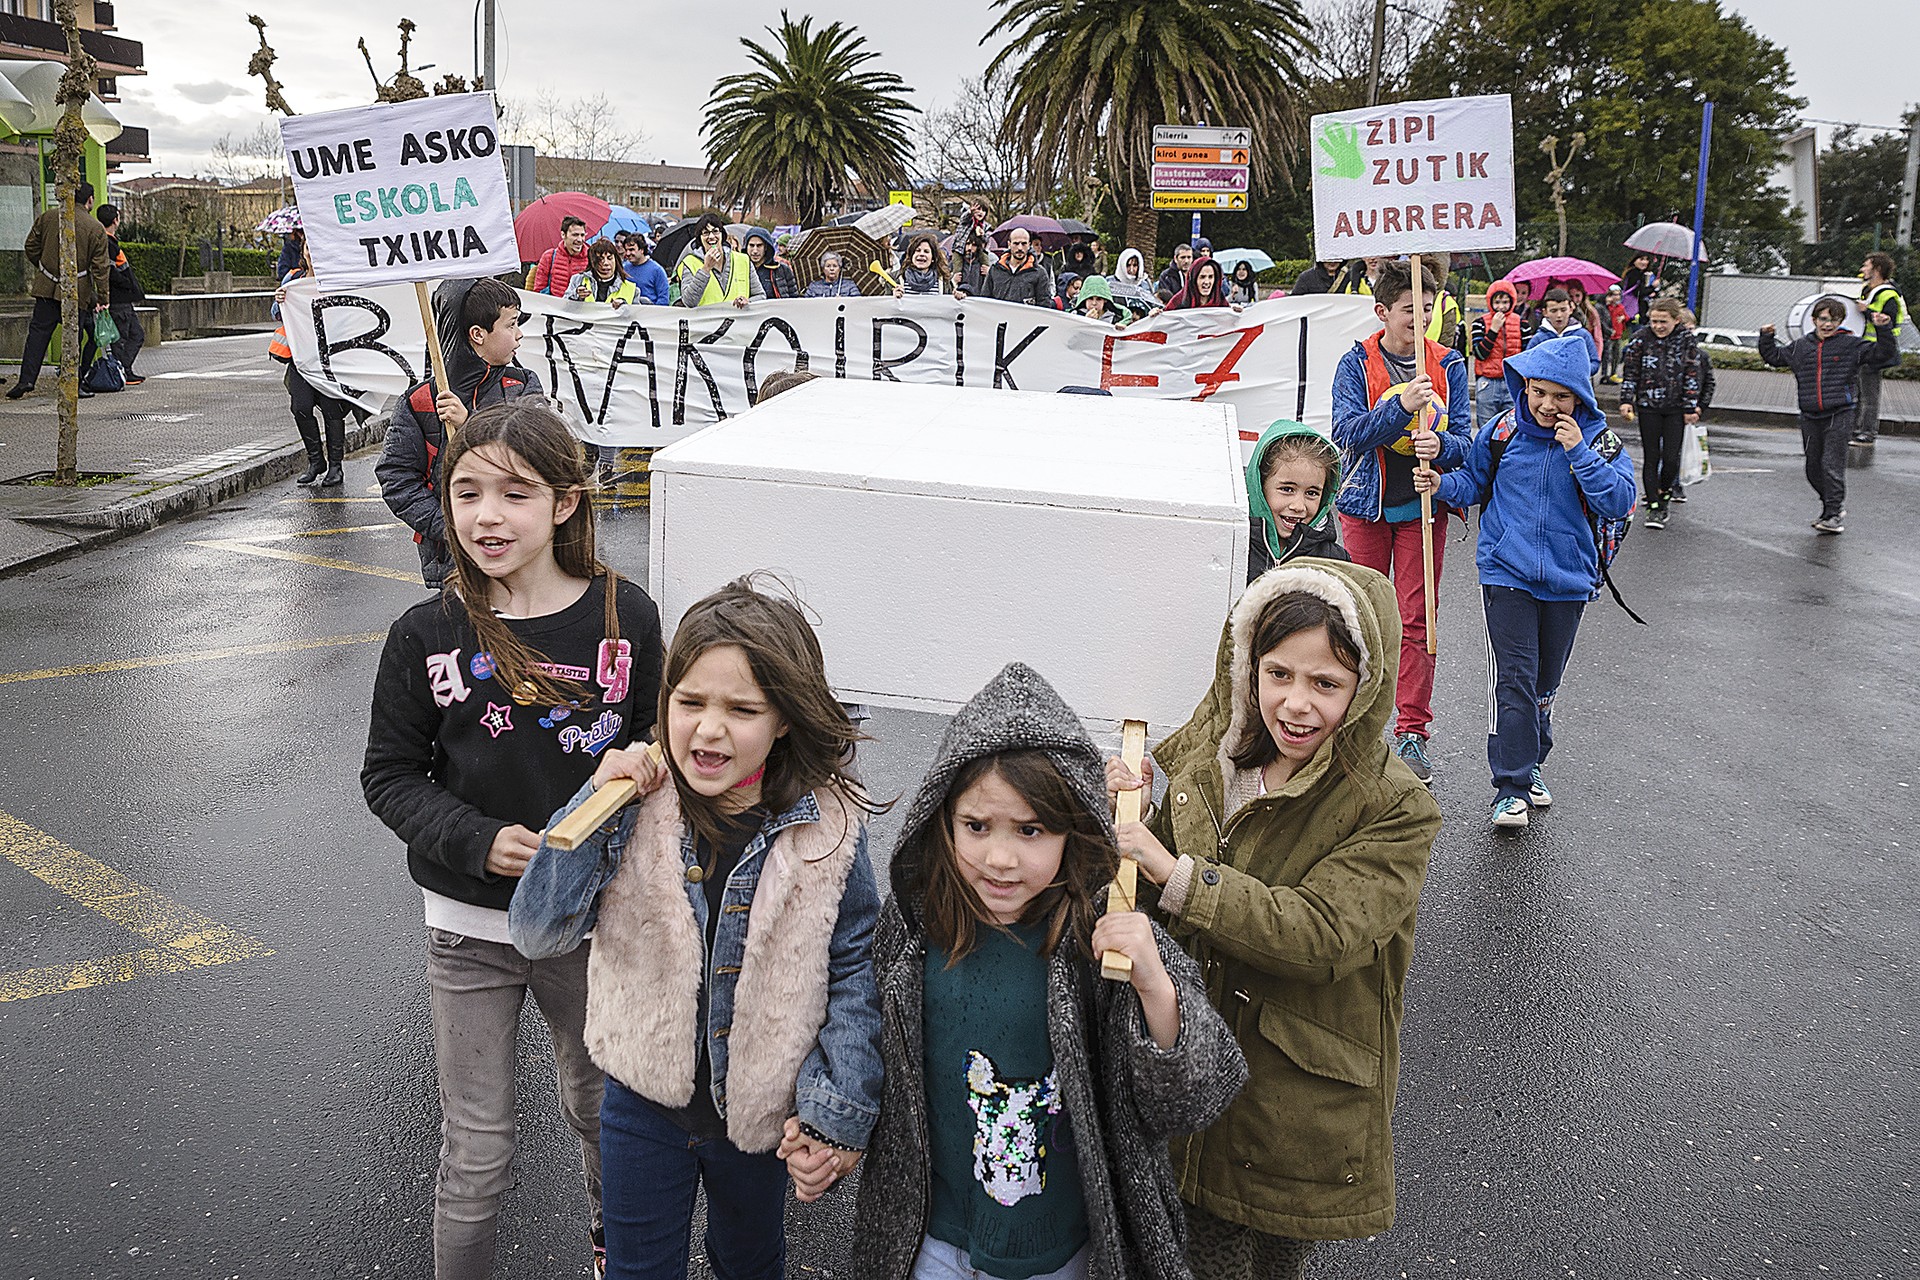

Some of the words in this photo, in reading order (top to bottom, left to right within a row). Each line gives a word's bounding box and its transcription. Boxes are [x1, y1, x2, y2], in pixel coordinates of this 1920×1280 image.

[1366, 115, 1435, 146] ZIPI
[291, 138, 376, 180] UME
[400, 125, 496, 166] ASKO
[1157, 150, 1177, 158] kirol
[1372, 152, 1489, 185] ZUTIK
[333, 177, 479, 225] ESKOLA
[1155, 196, 1216, 204] Hipermerkatua
[1333, 202, 1503, 238] AURRERA
[359, 225, 488, 267] TXIKIA
[558, 709, 623, 754] Pretty
